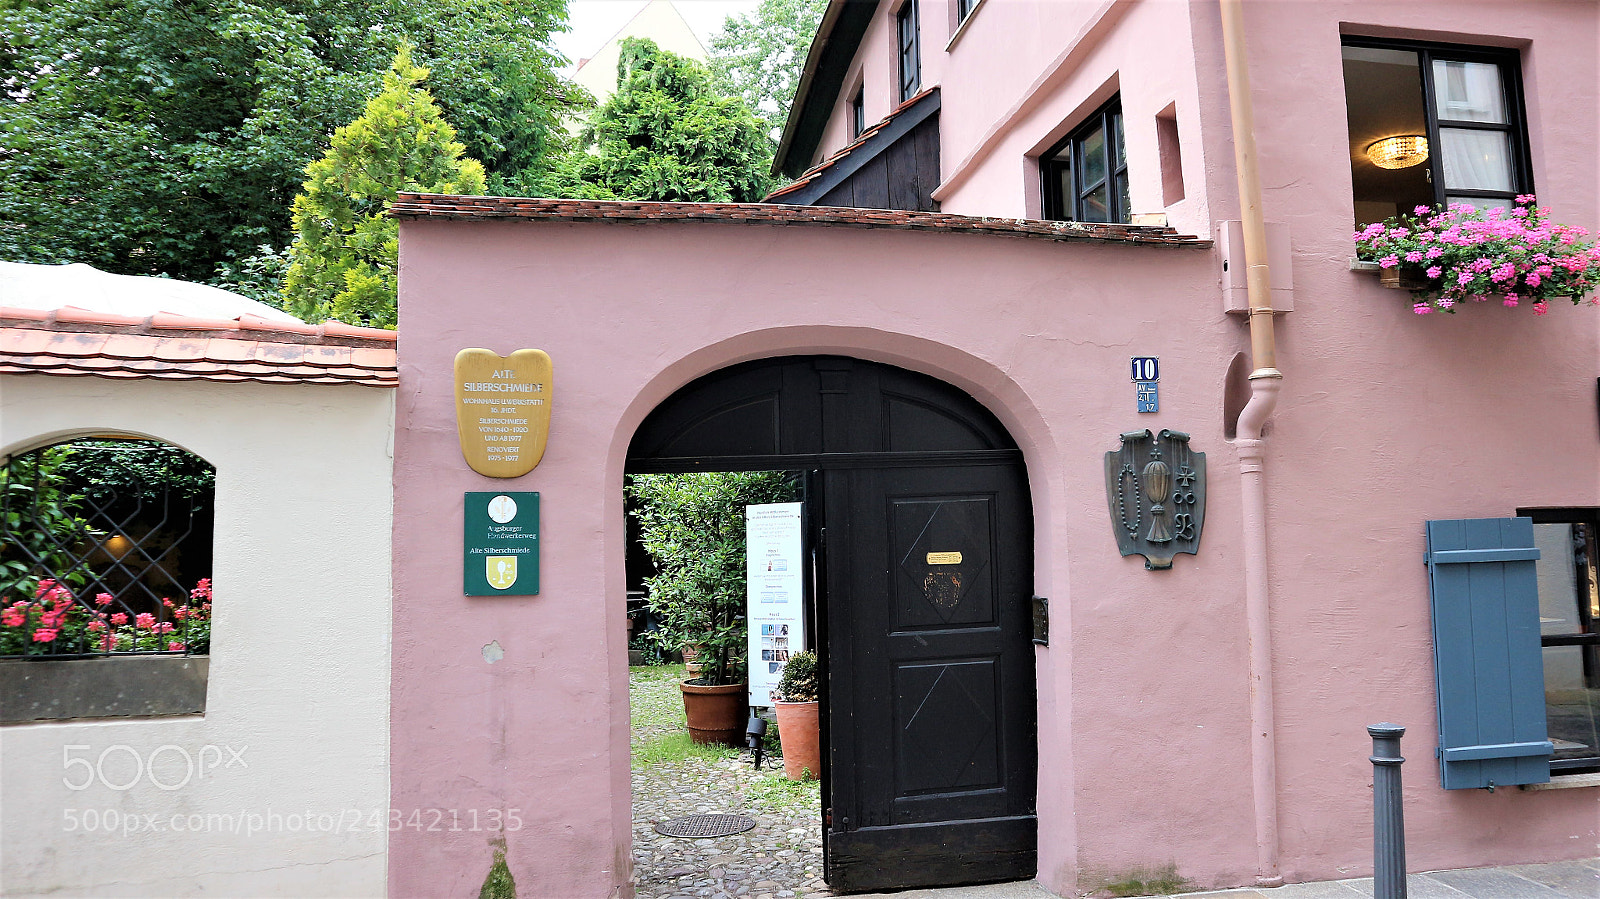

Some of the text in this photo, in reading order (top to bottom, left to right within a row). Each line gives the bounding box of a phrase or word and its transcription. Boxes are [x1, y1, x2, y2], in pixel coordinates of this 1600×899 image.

[491, 369, 516, 379] ALTE
[1133, 359, 1155, 380] 10
[463, 382, 543, 393] SILBERSCHMIEDE
[488, 525, 522, 533] Augsburger
